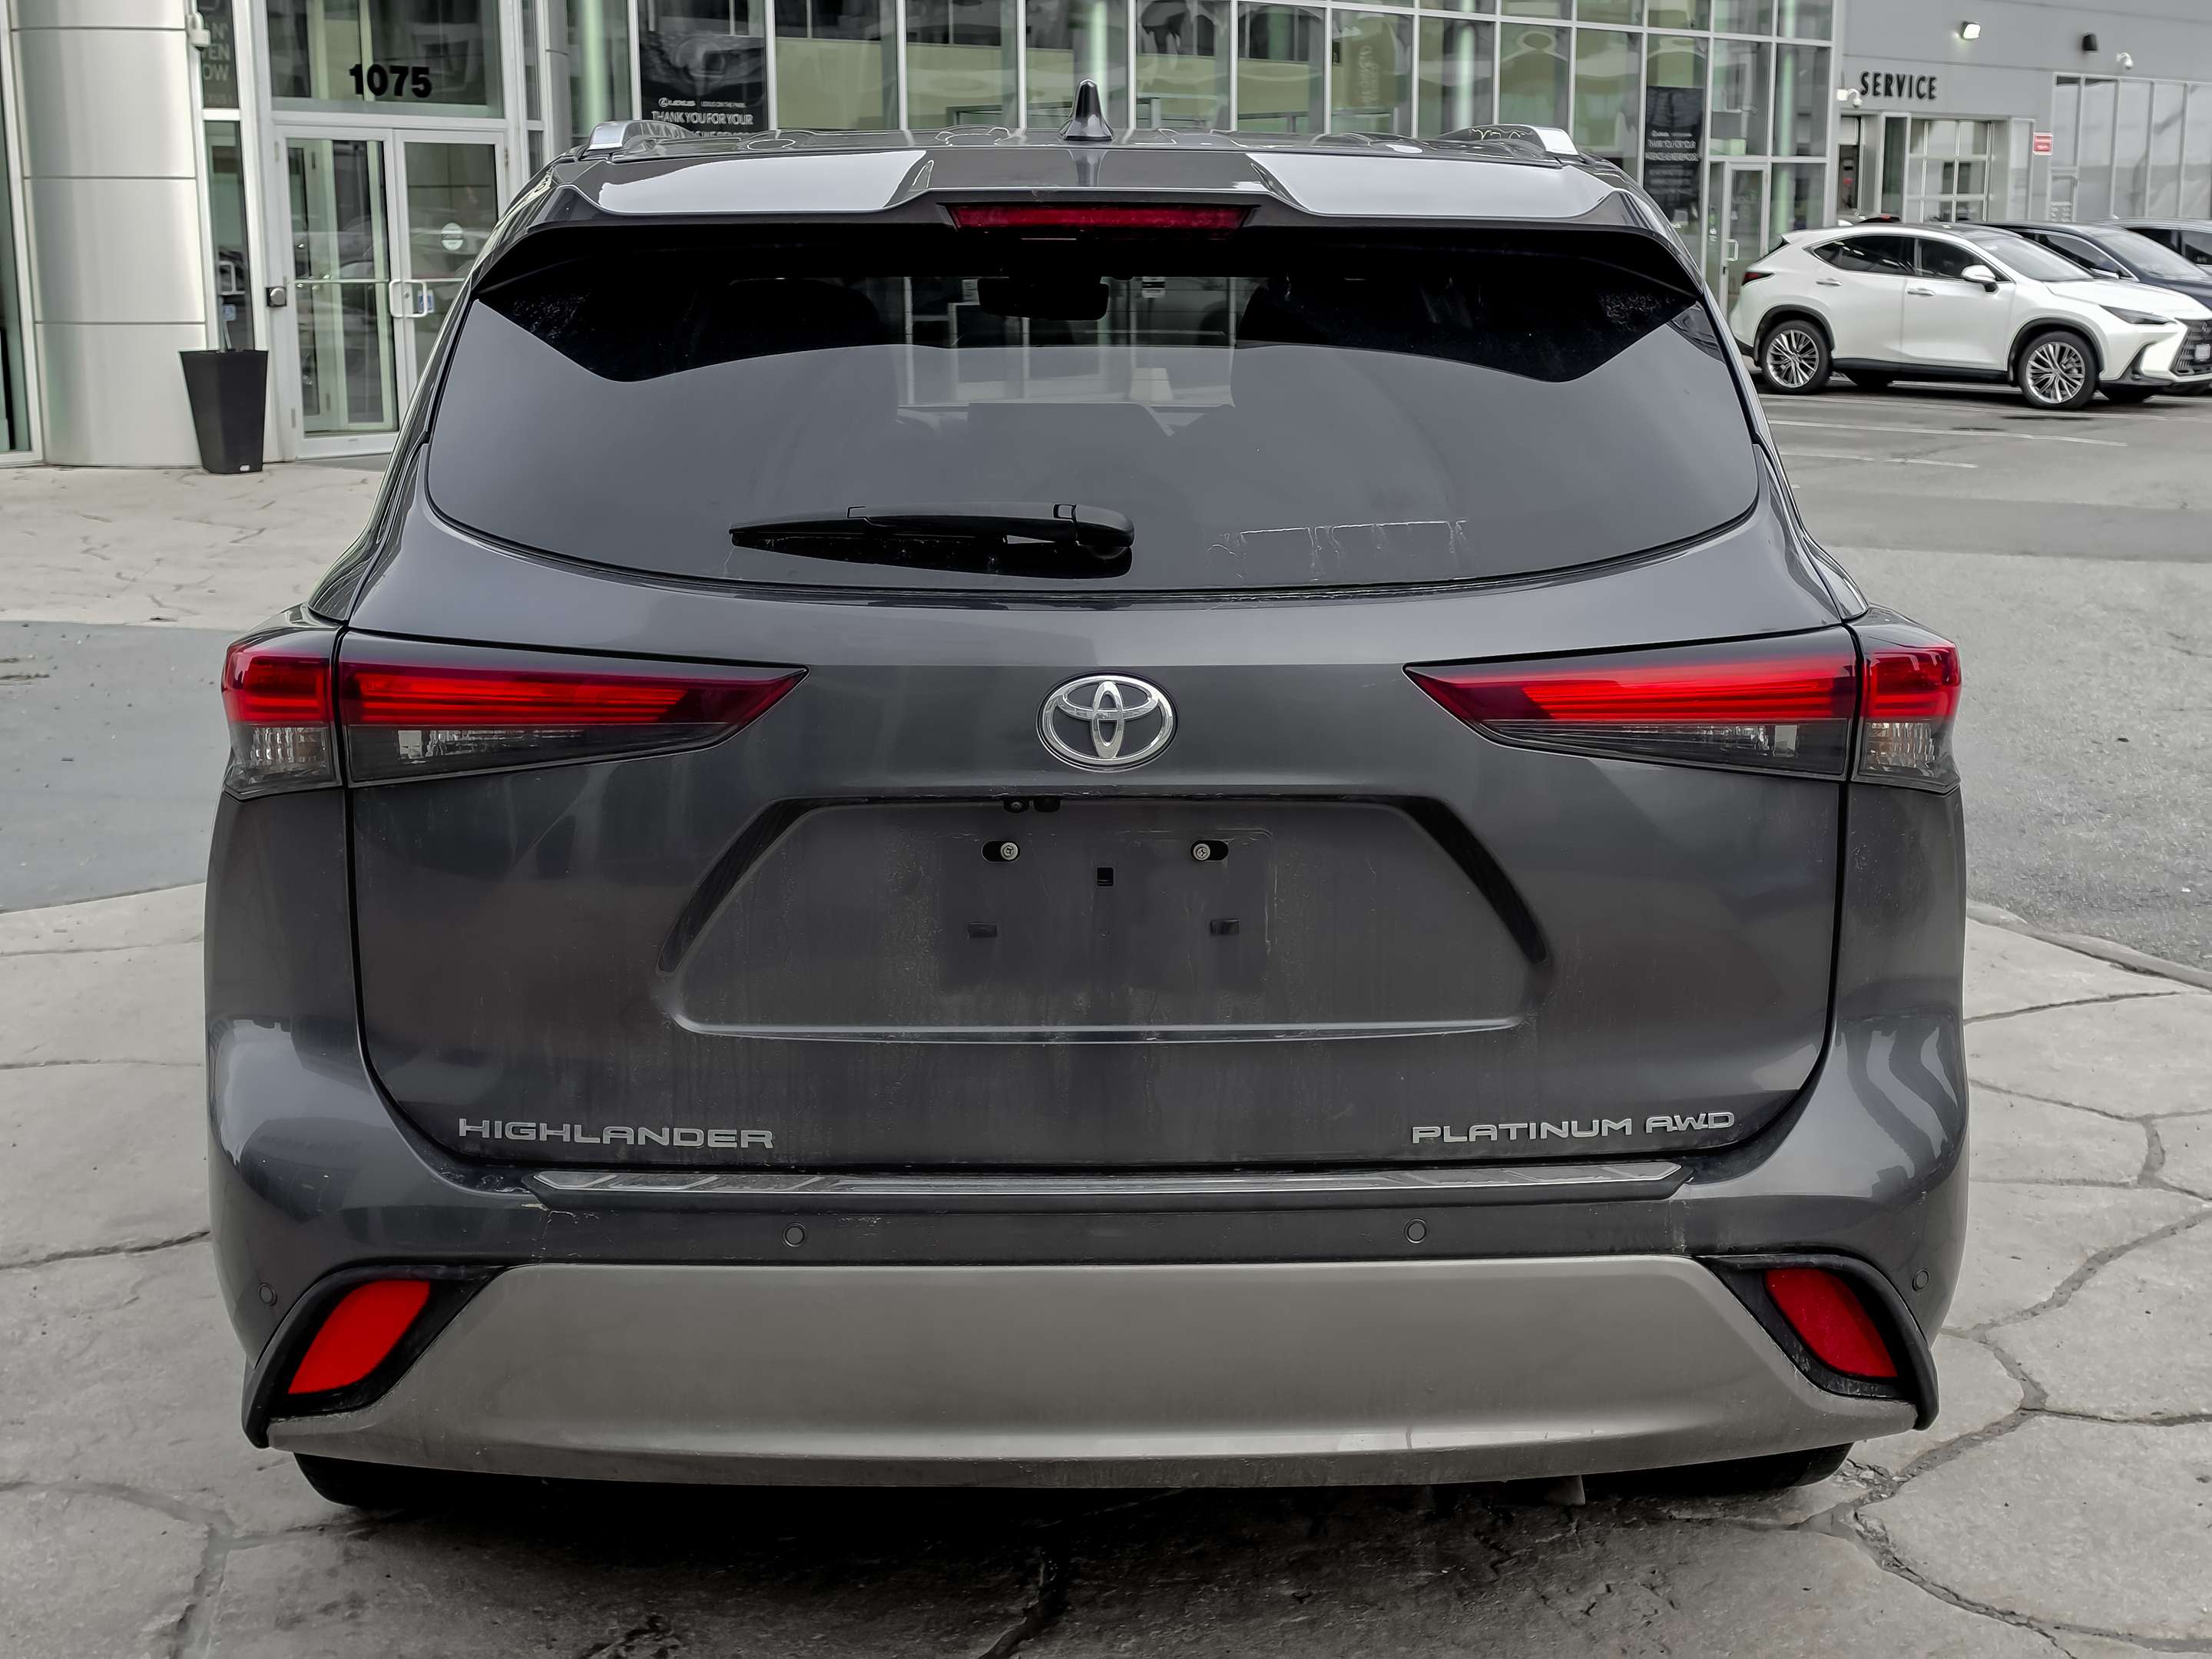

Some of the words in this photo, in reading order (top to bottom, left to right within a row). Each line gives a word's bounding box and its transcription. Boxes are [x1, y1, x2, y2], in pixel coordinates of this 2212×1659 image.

[203, 64, 230, 81] OW
[349, 64, 432, 98] 1075
[1860, 71, 1936, 100] SERVICE
[651, 111, 685, 123] THANK
[685, 112, 707, 124] YOU
[707, 113, 727, 124] FOR
[726, 114, 753, 125] YOUR
[459, 1118, 773, 1149] HIGHLANDER
[1412, 1118, 1632, 1144] PLATINUM
[1646, 1111, 1735, 1134] AWD
